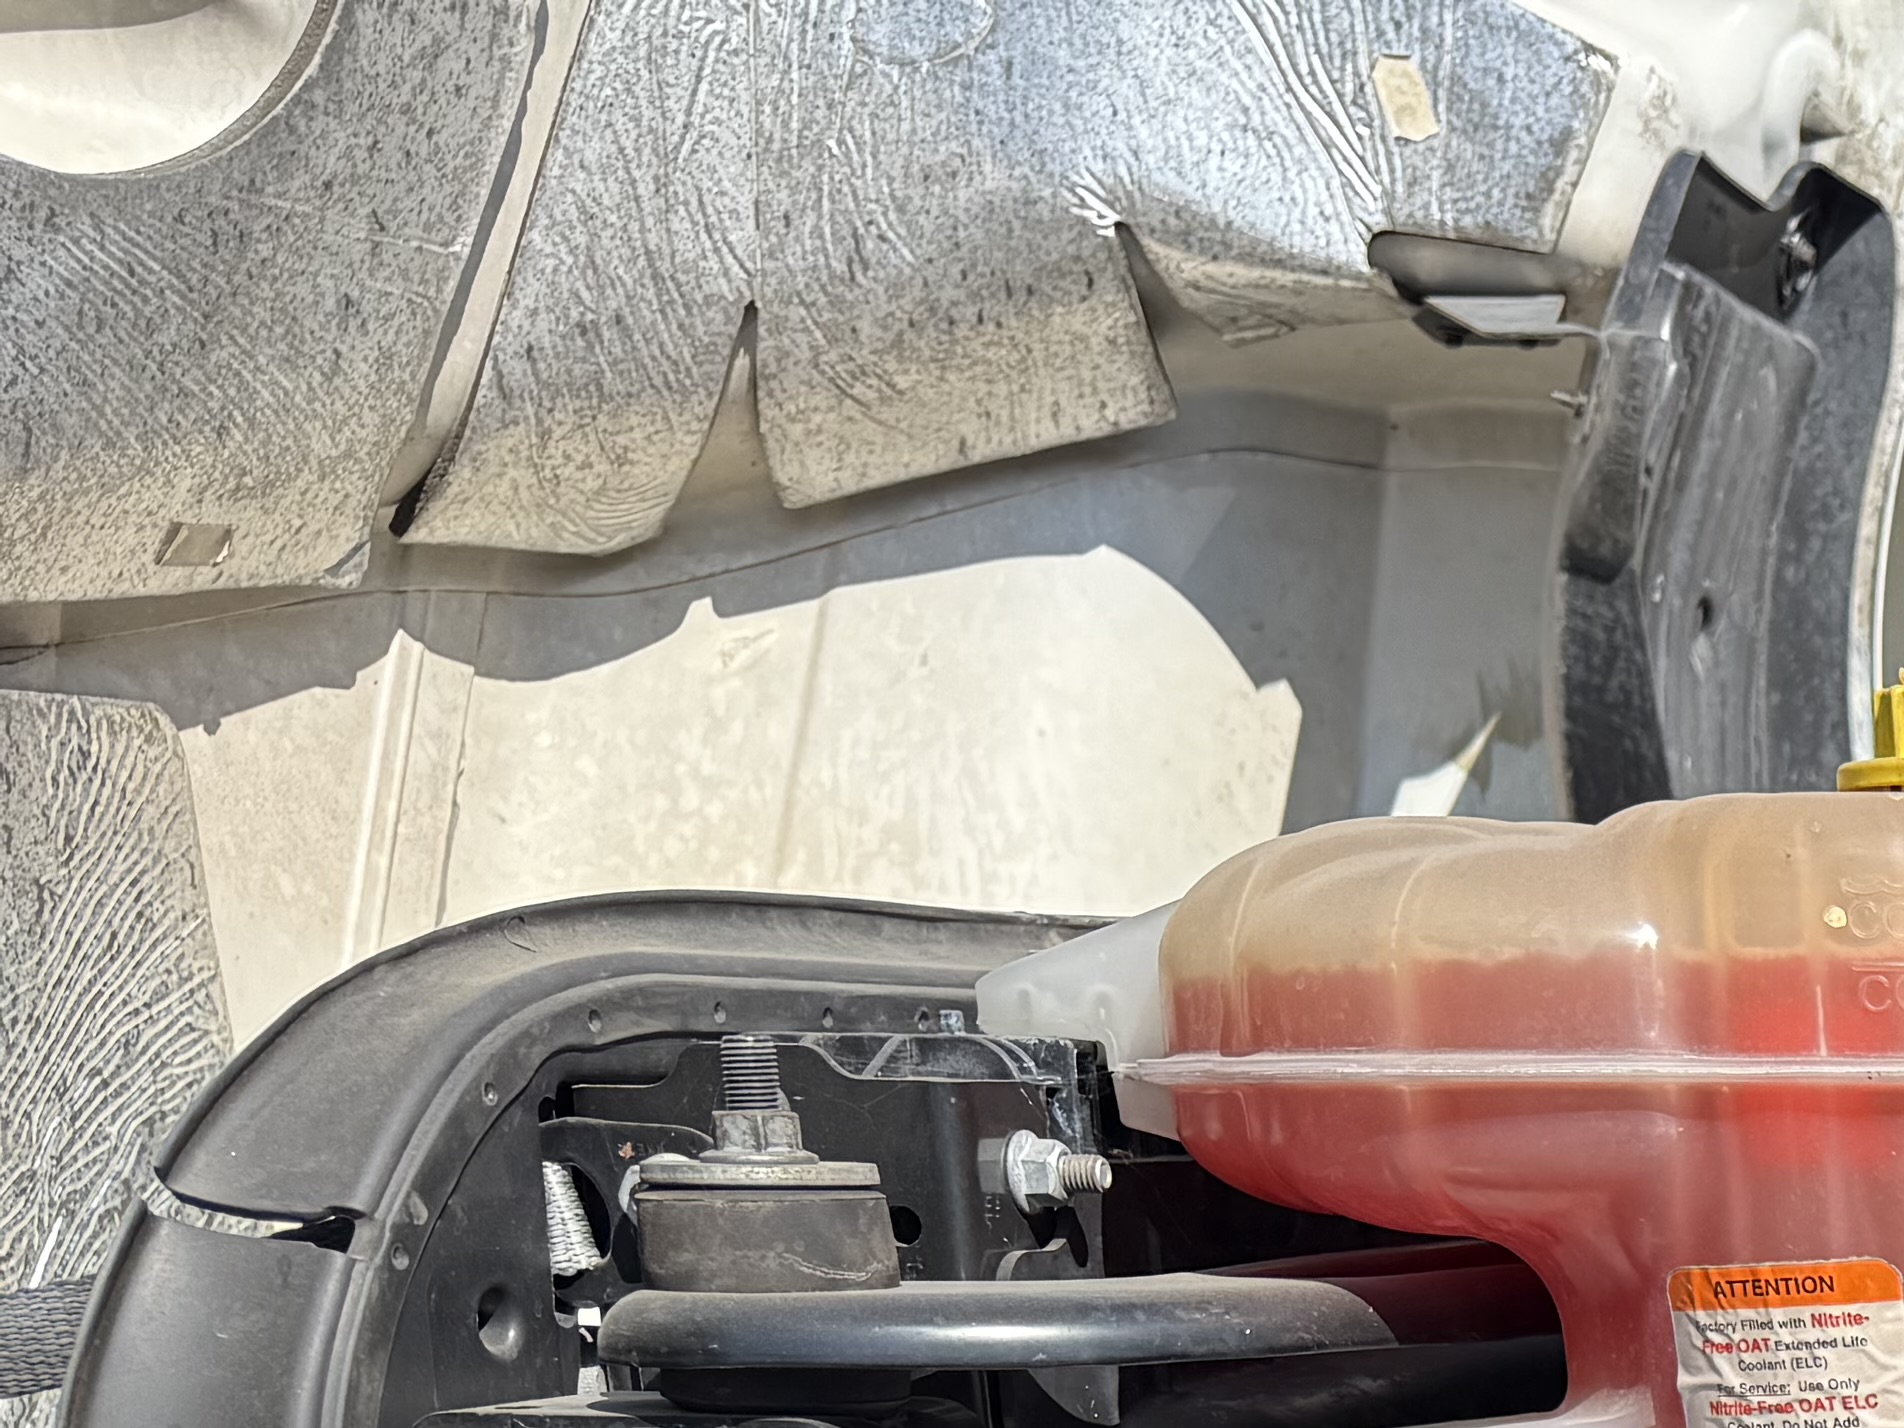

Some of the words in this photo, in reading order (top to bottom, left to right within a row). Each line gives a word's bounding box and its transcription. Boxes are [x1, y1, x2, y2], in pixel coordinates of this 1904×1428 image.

[1713, 1275, 1835, 1299] ATTENTION
[1740, 1318, 1774, 1331] Filled
[1777, 1316, 1807, 1330] with
[1811, 1312, 1870, 1330] Nitrite-
[1702, 1340, 1734, 1354] Free
[1737, 1338, 1772, 1354] OAT
[1774, 1337, 1838, 1351] Extended
[1842, 1335, 1869, 1349] Life
[1738, 1358, 1788, 1373] Coolant
[1790, 1356, 1829, 1372] (ELC)
[1717, 1383, 1735, 1396] For
[1739, 1381, 1791, 1396] Service:
[1798, 1379, 1824, 1393] Use
[1828, 1378, 1861, 1395] Only
[1710, 1399, 1794, 1417] Nitrite-Free
[1799, 1396, 1836, 1413] OAT
[1842, 1394, 1879, 1411] ELC
